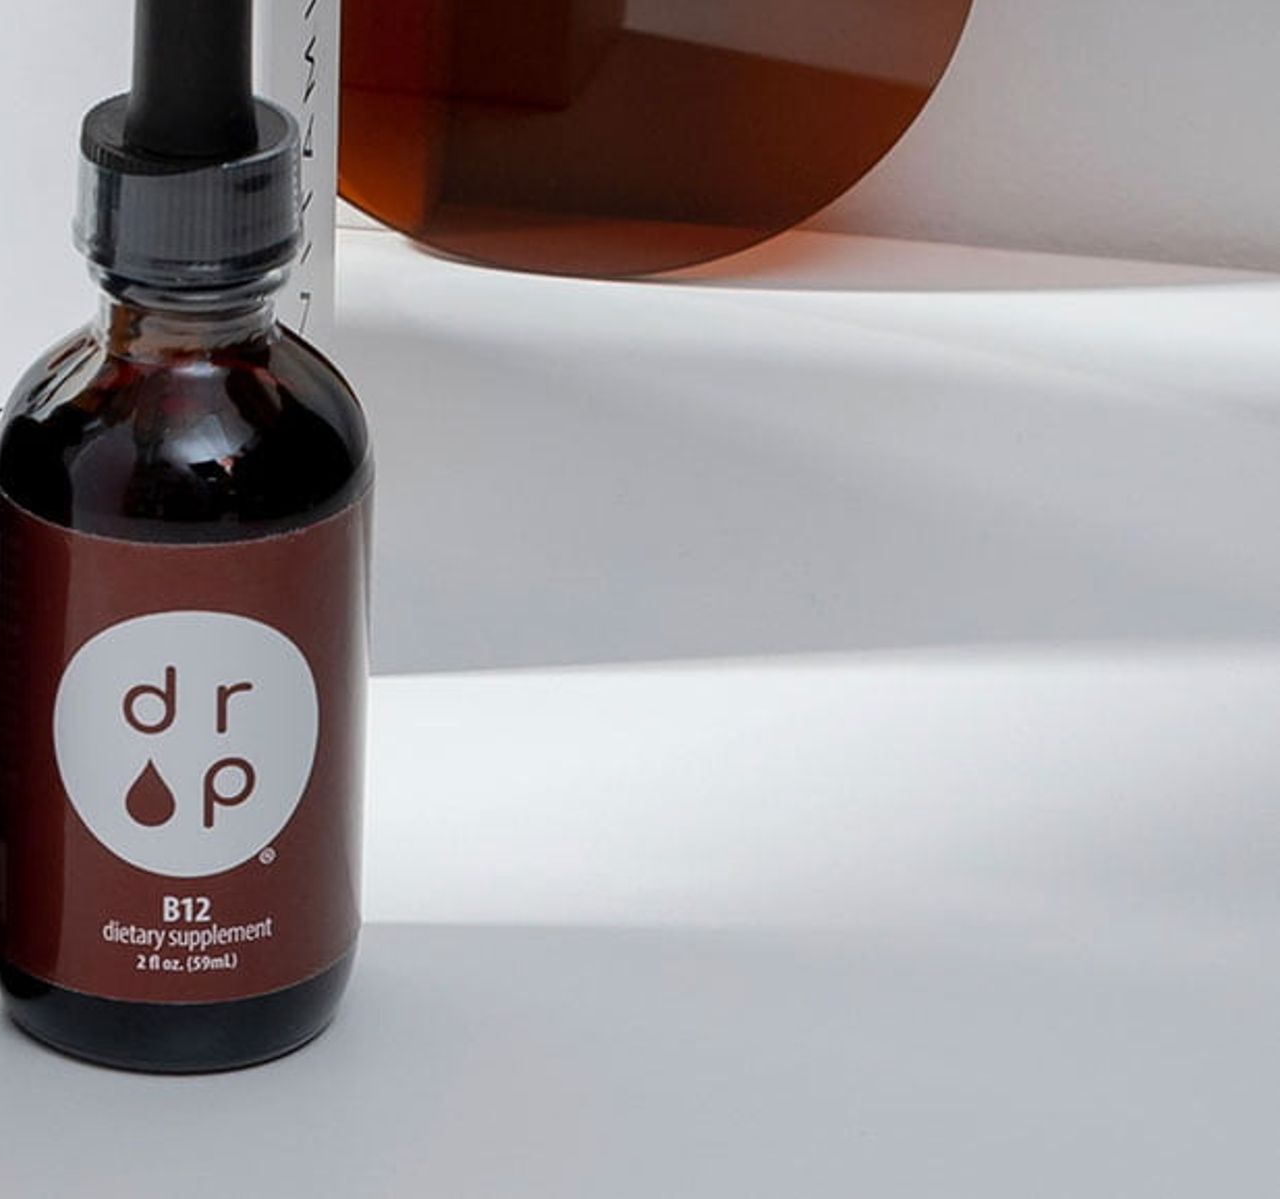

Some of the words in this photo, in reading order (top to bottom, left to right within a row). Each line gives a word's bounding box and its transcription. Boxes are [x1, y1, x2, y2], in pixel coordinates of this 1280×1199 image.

[162, 896, 212, 923] B12
[102, 920, 166, 951] dietary
[167, 917, 273, 952] supplement
[136, 954, 147, 970] 2
[148, 954, 160, 970] fl
[186, 952, 238, 973] (59mL)
